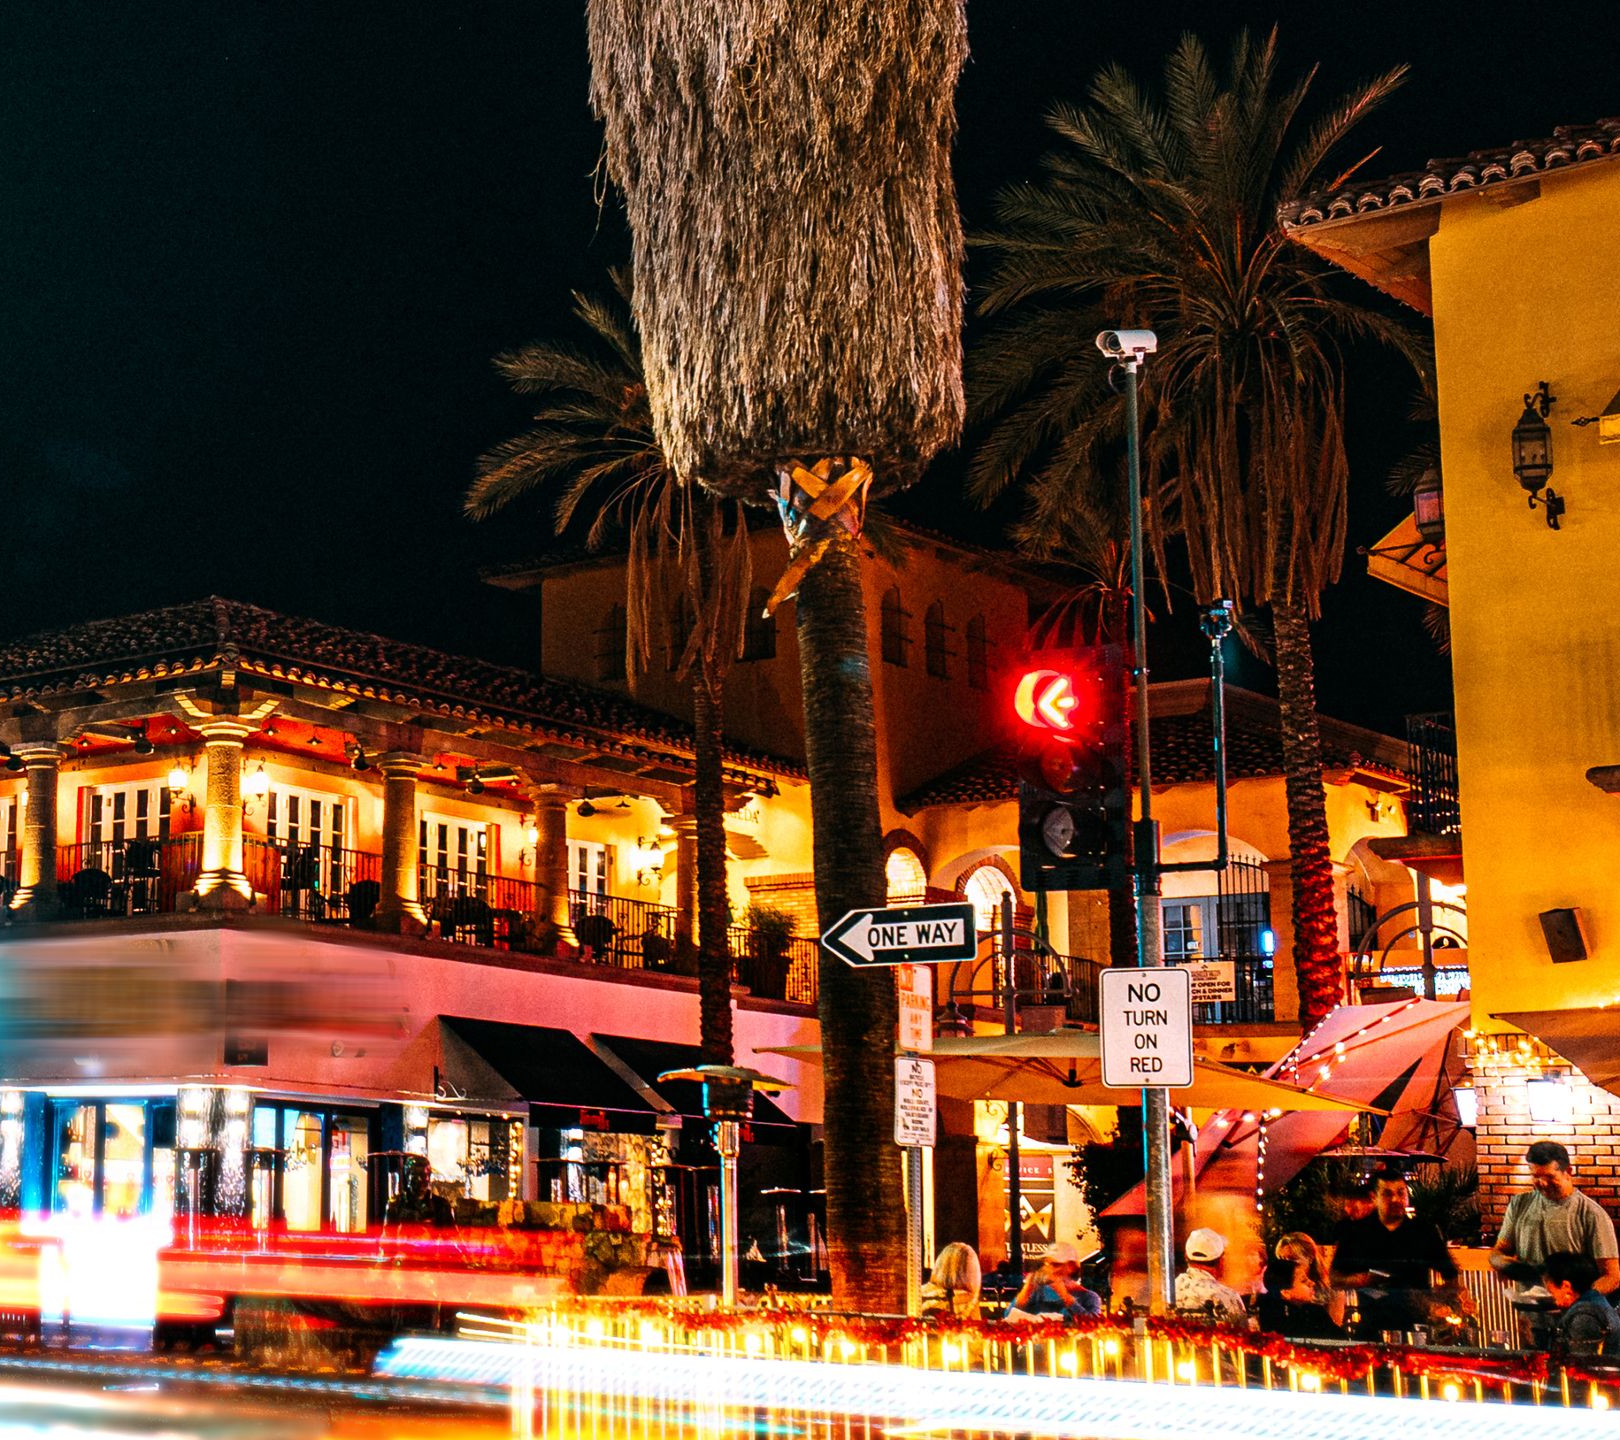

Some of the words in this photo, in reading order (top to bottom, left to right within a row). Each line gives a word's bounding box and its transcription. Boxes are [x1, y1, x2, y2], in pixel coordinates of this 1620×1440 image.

[868, 926, 908, 948] ONE
[916, 922, 958, 945] WAY
[1128, 983, 1161, 1002] NO
[1123, 1010, 1167, 1026] TURN
[1134, 1033, 1157, 1049] ON
[1130, 1057, 1163, 1072] RED
